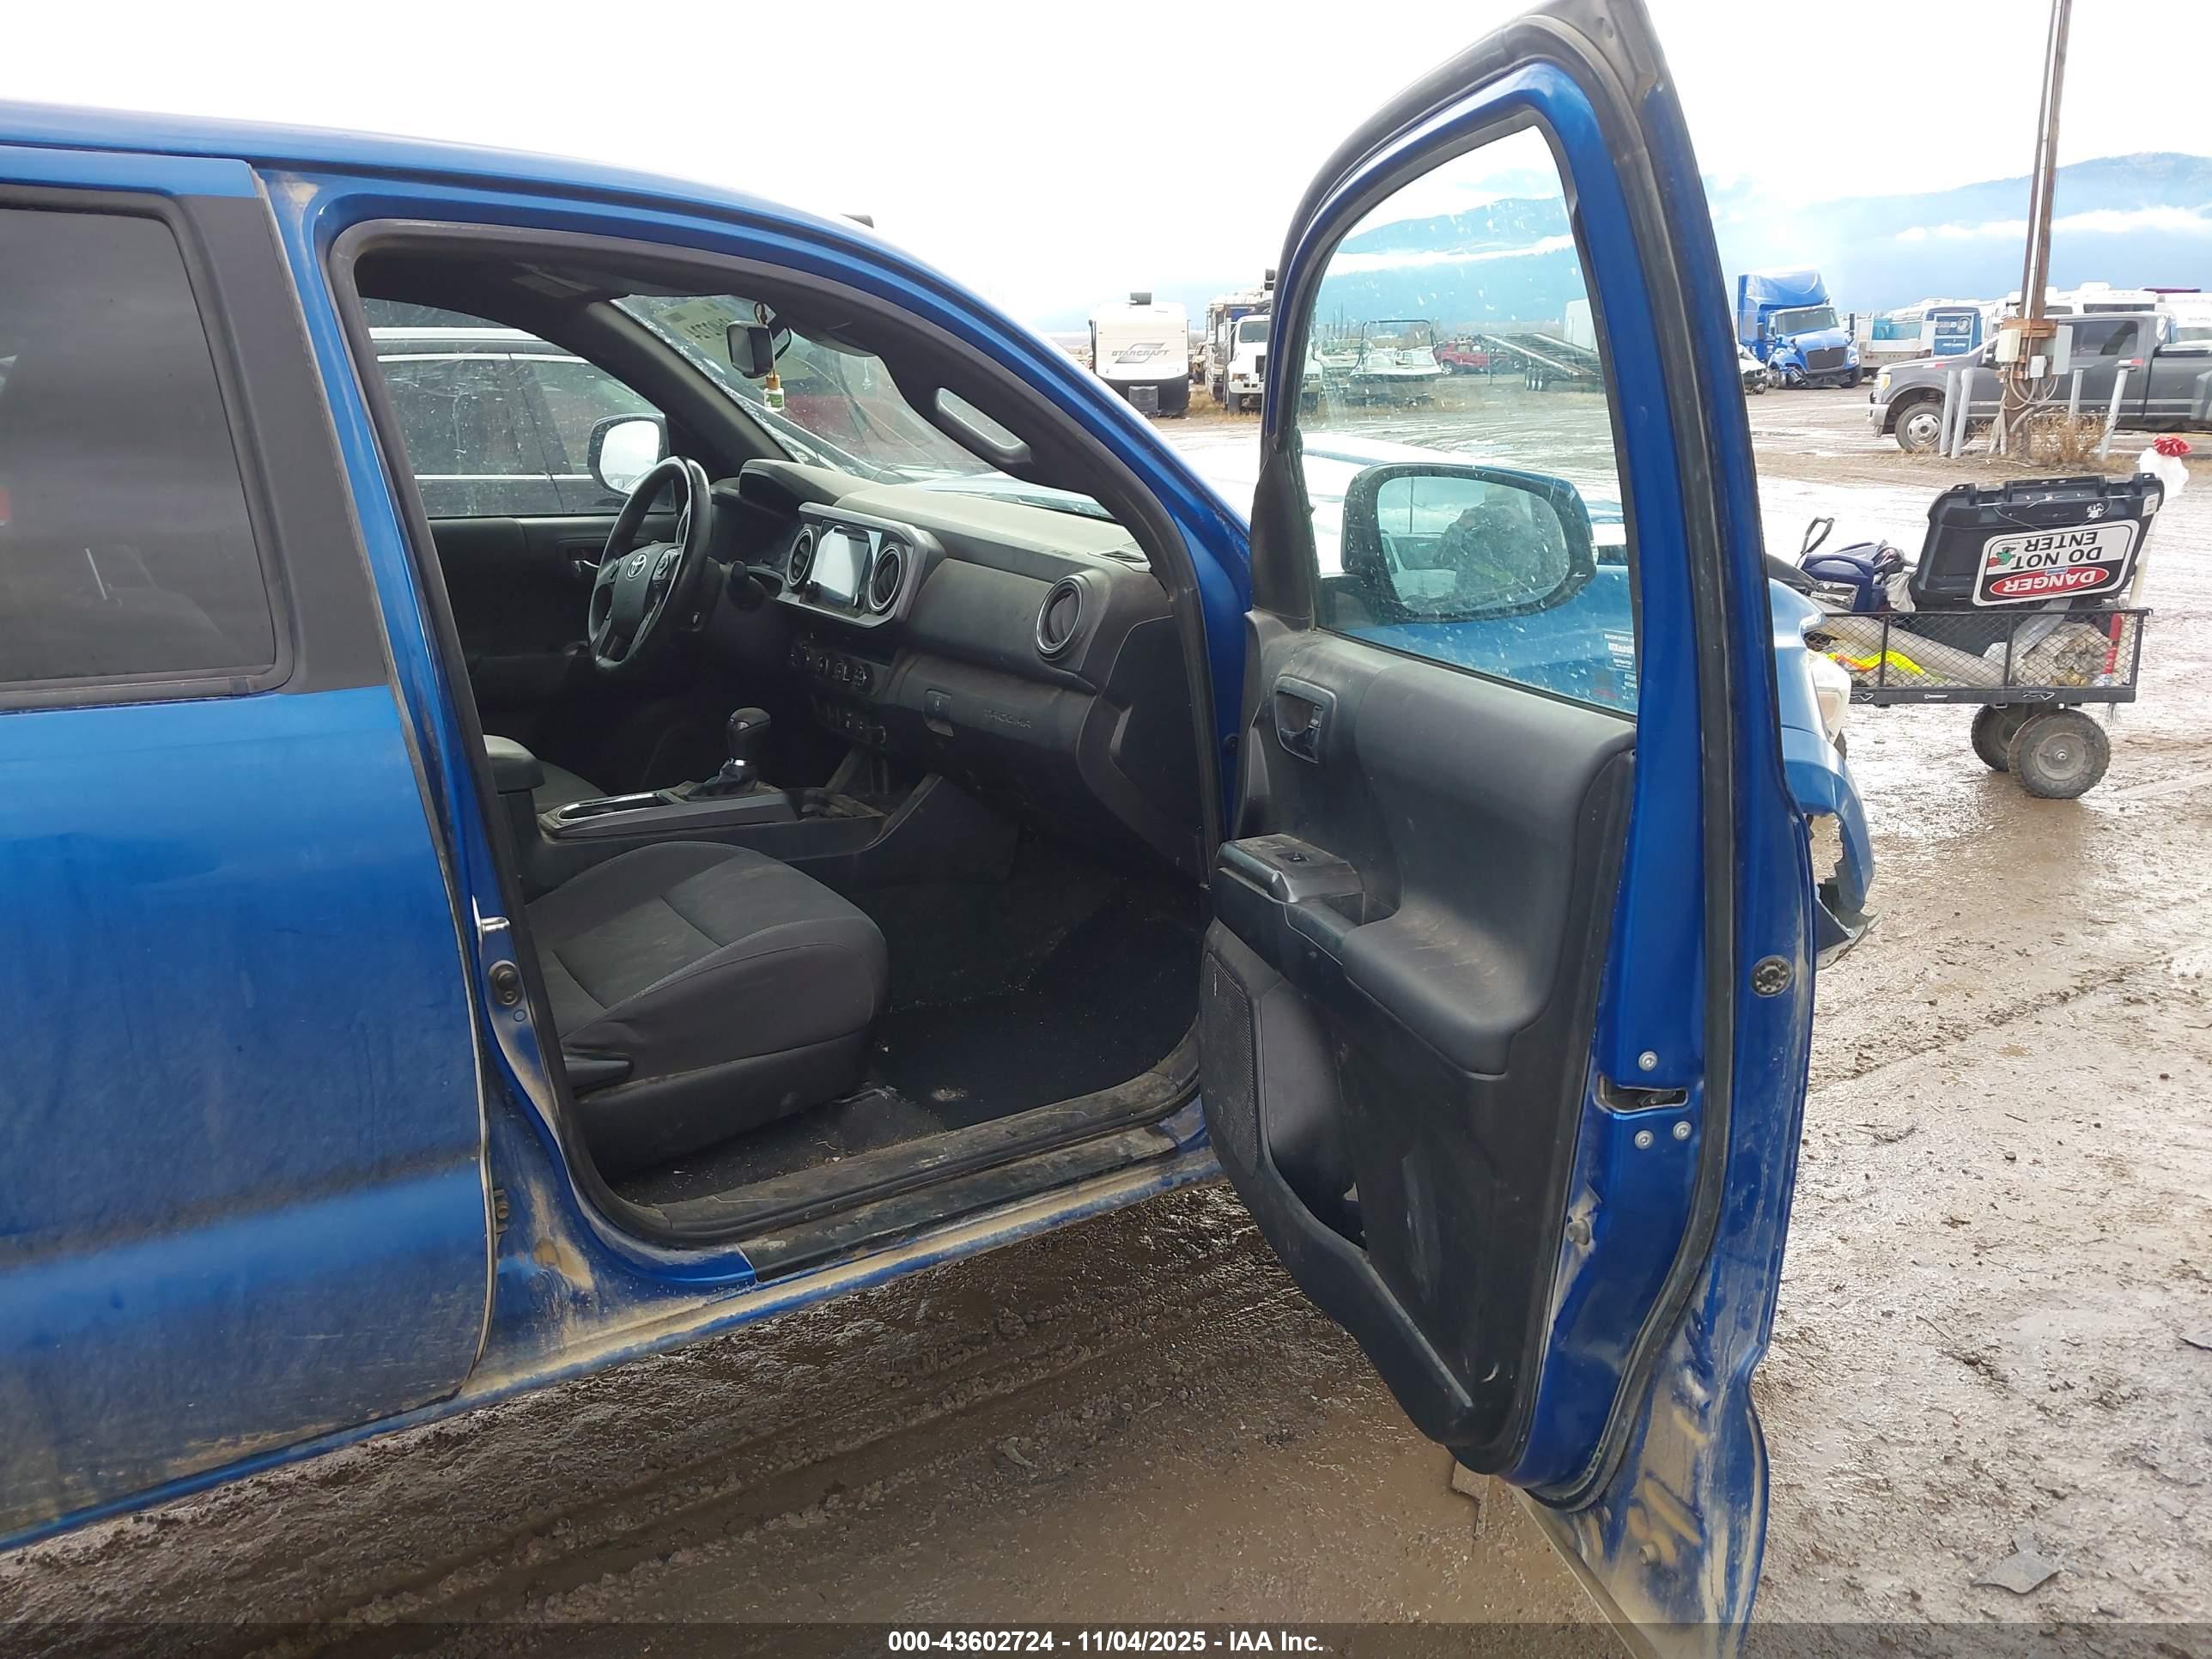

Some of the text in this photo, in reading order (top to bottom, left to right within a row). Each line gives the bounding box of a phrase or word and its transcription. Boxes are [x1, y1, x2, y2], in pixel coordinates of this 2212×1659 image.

[2024, 532, 2099, 552] ENTER
[2011, 546, 2103, 570] DO NOT
[2002, 570, 2096, 592] DANGER
